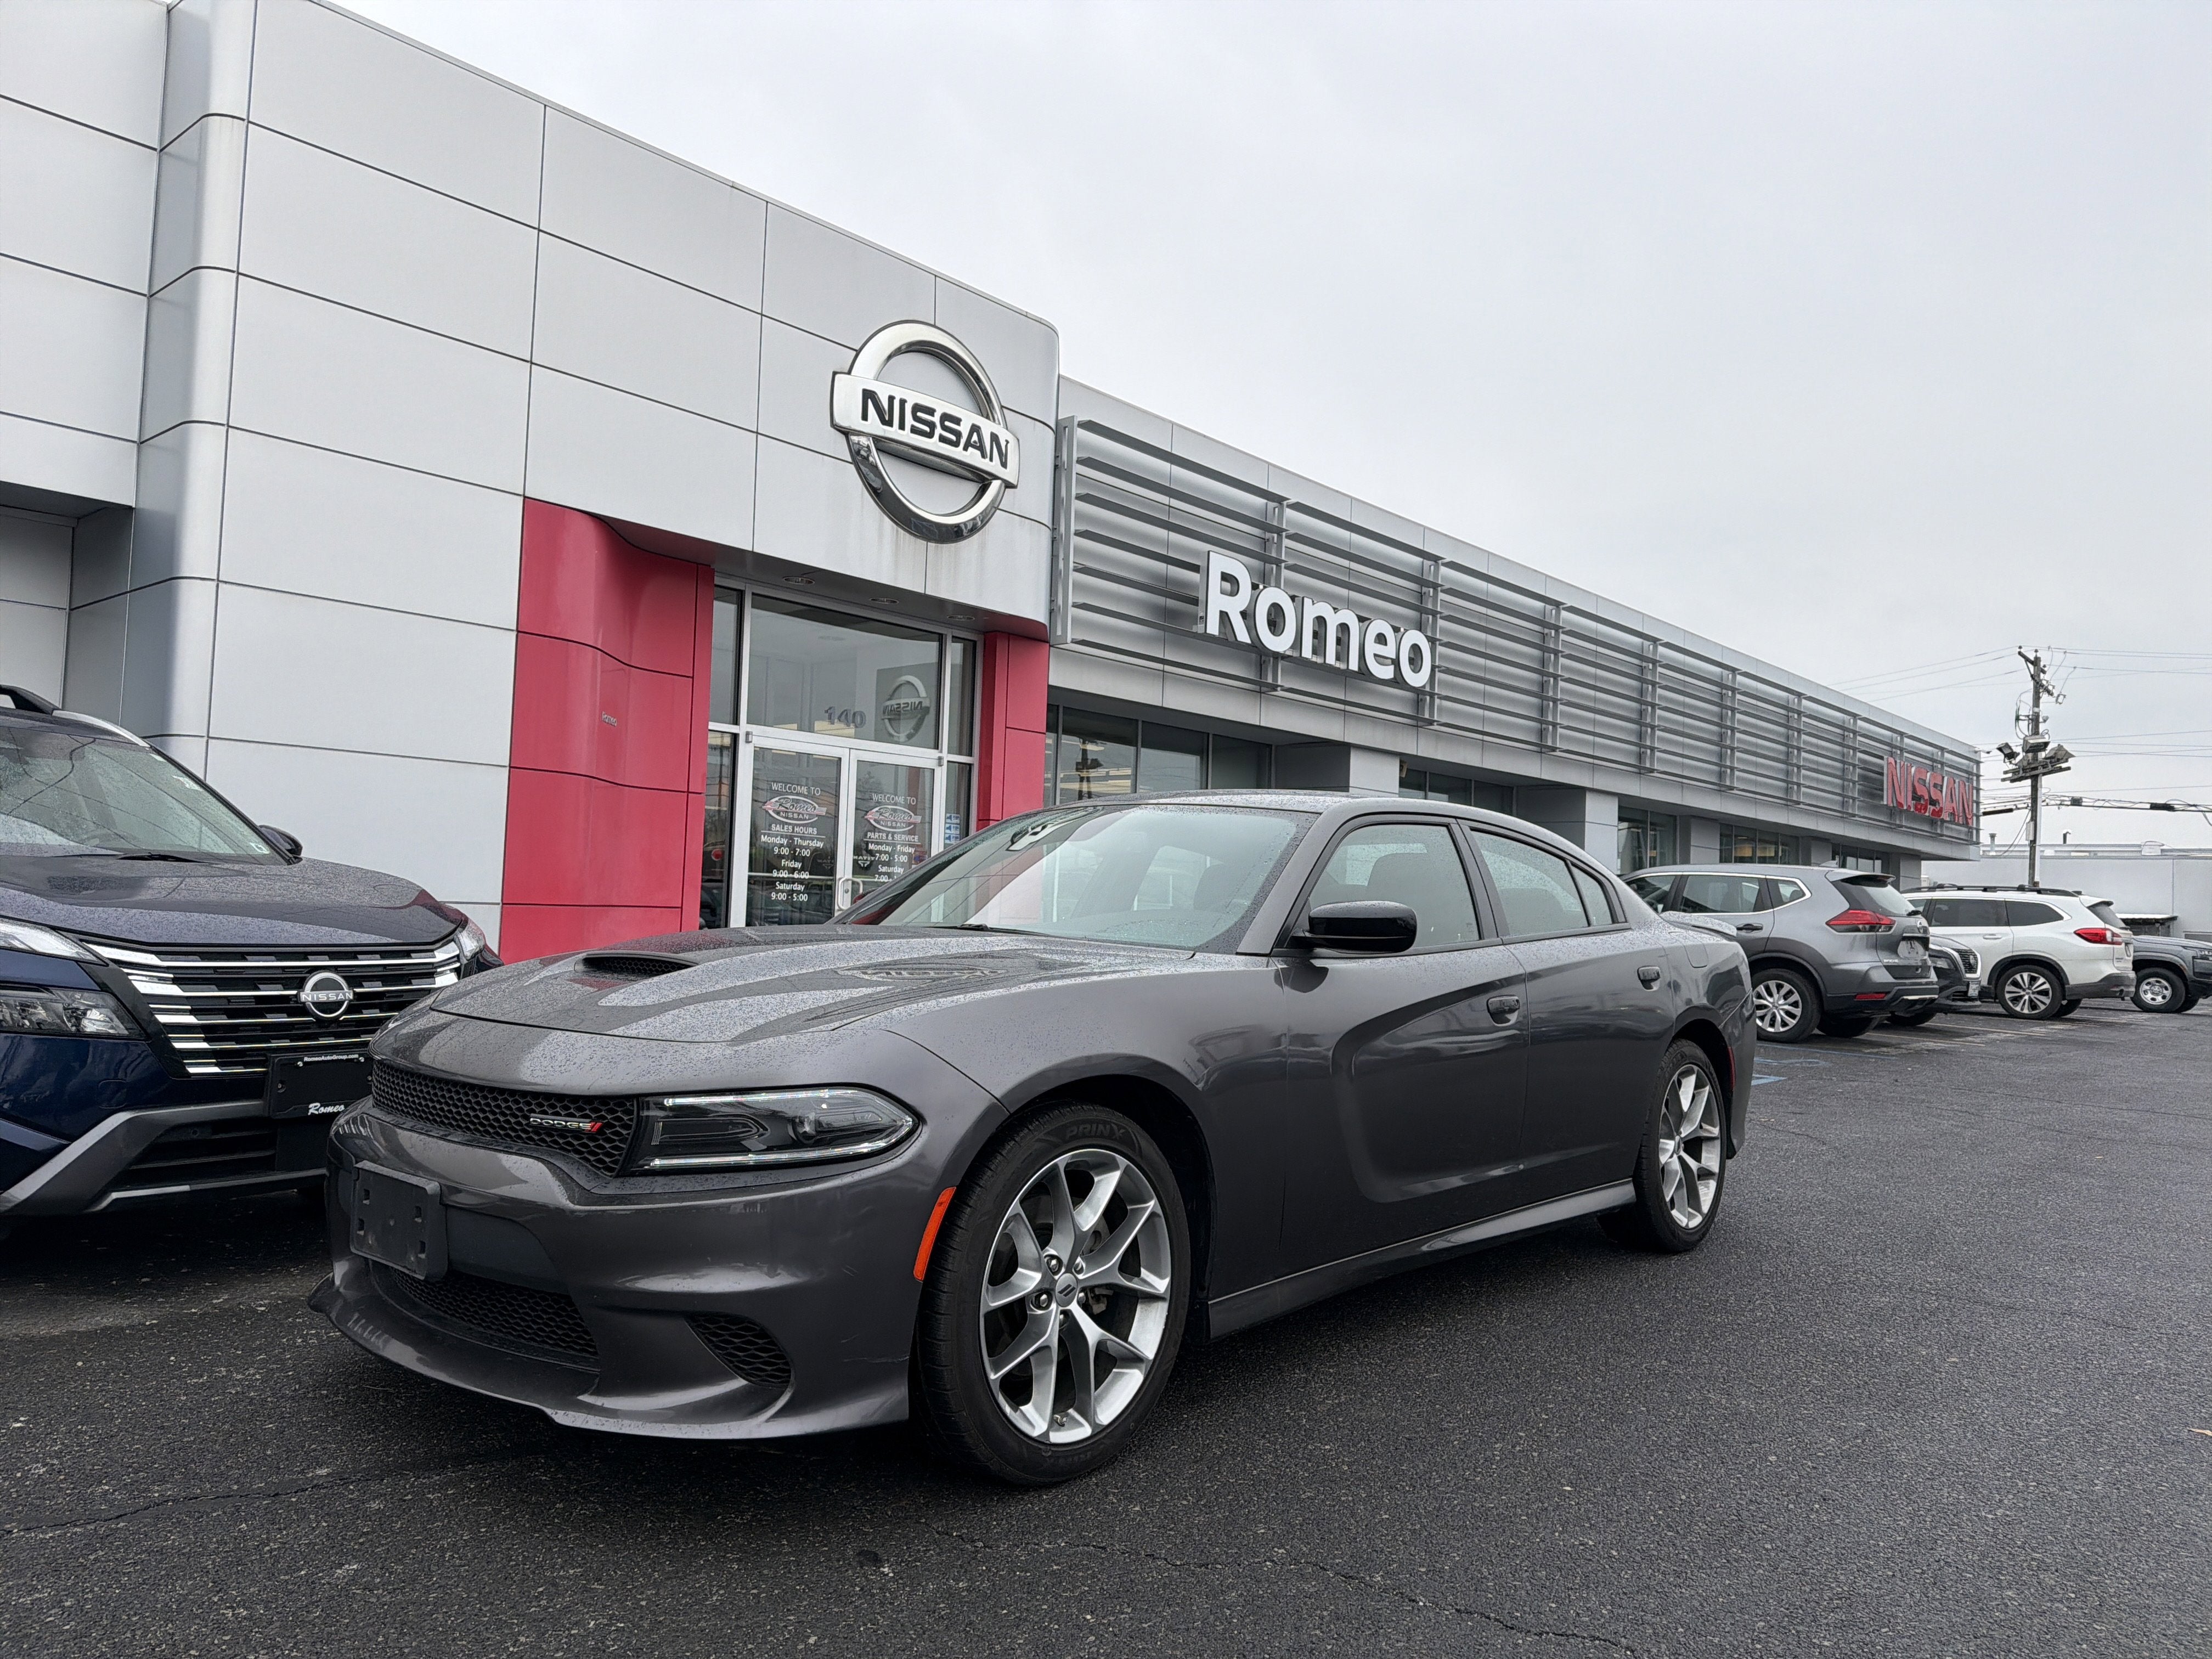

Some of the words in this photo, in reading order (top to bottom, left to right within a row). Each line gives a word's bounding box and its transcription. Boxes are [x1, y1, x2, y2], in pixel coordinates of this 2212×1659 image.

[861, 388, 1009, 470] NISSAN
[1206, 550, 1431, 687] Romeo
[825, 706, 866, 729] 140
[771, 782, 808, 794] WELCOME
[810, 787, 821, 795] TO
[1887, 757, 1973, 826] NISSAN
[872, 793, 905, 804] WELCOME
[776, 797, 816, 812] Romeo
[780, 811, 809, 820] NISSAN
[877, 807, 912, 821] Romeo
[771, 823, 792, 832] SALES
[794, 826, 817, 834] HOURS
[761, 834, 788, 845] Monday
[794, 837, 824, 848] Thursday
[867, 832, 886, 840] PARTS
[894, 834, 918, 842] SERVICE
[774, 847, 789, 855] 9:00
[795, 848, 810, 856] 7:00
[868, 843, 892, 853] Monday
[897, 845, 915, 854] Friday
[781, 859, 802, 869] Friday
[878, 865, 904, 874] Saturday
[772, 870, 788, 878] 9:00
[776, 882, 805, 891] Saturday
[771, 892, 787, 900] 9:00
[302, 992, 353, 1002] NISSAN
[308, 1102, 345, 1116] Romeo
[530, 1118, 591, 1130] DODGE
